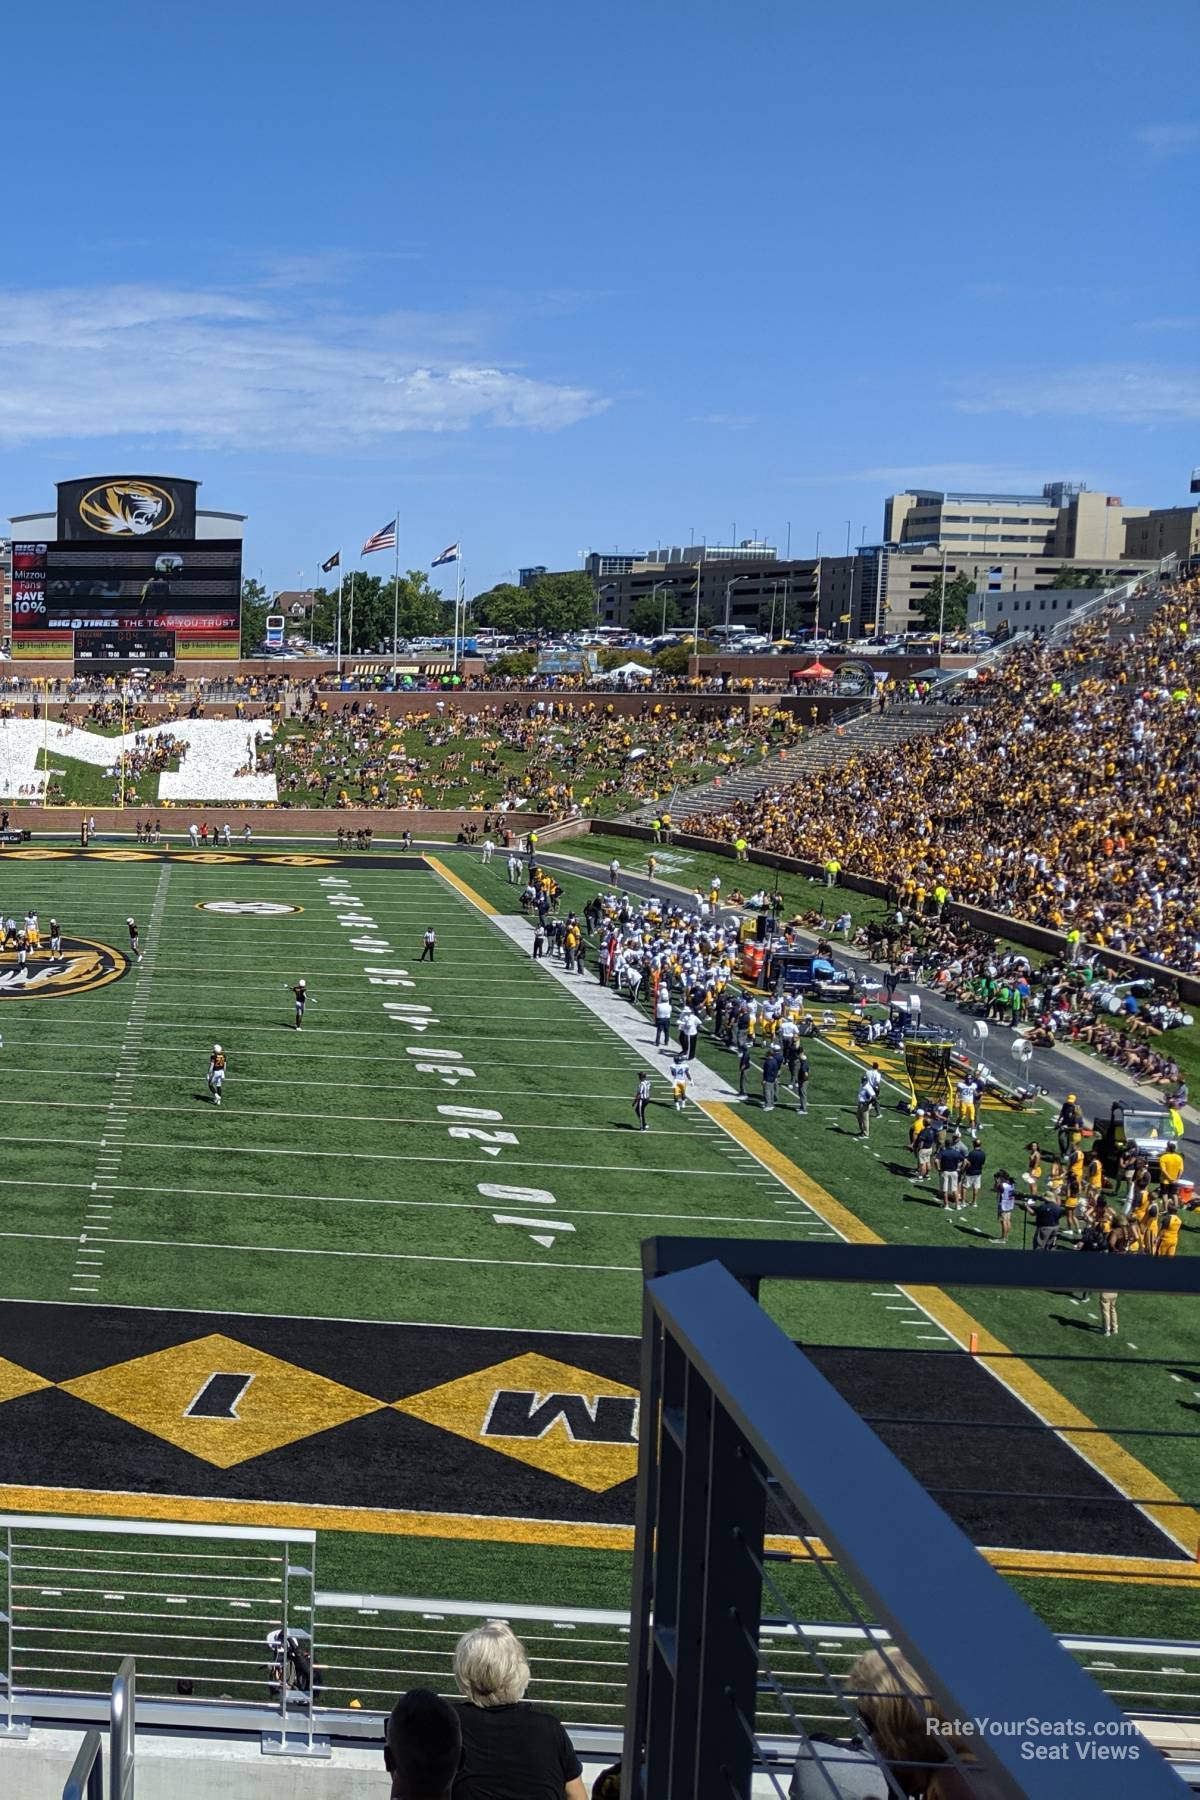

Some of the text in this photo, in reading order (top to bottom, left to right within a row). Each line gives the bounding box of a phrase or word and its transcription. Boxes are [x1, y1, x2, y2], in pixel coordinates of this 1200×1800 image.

[14, 570, 46, 579] Mizzou
[20, 580, 41, 589] Fans
[16, 591, 44, 601] SAVE
[14, 601, 46, 613] 10%
[48, 619, 71, 627] BIG
[83, 619, 119, 627] TIRES
[123, 618, 236, 627] THE TEAM YOU TRUST
[405, 1046, 477, 1078] 30
[436, 1104, 521, 1145] 20
[477, 1182, 577, 1233] 10
